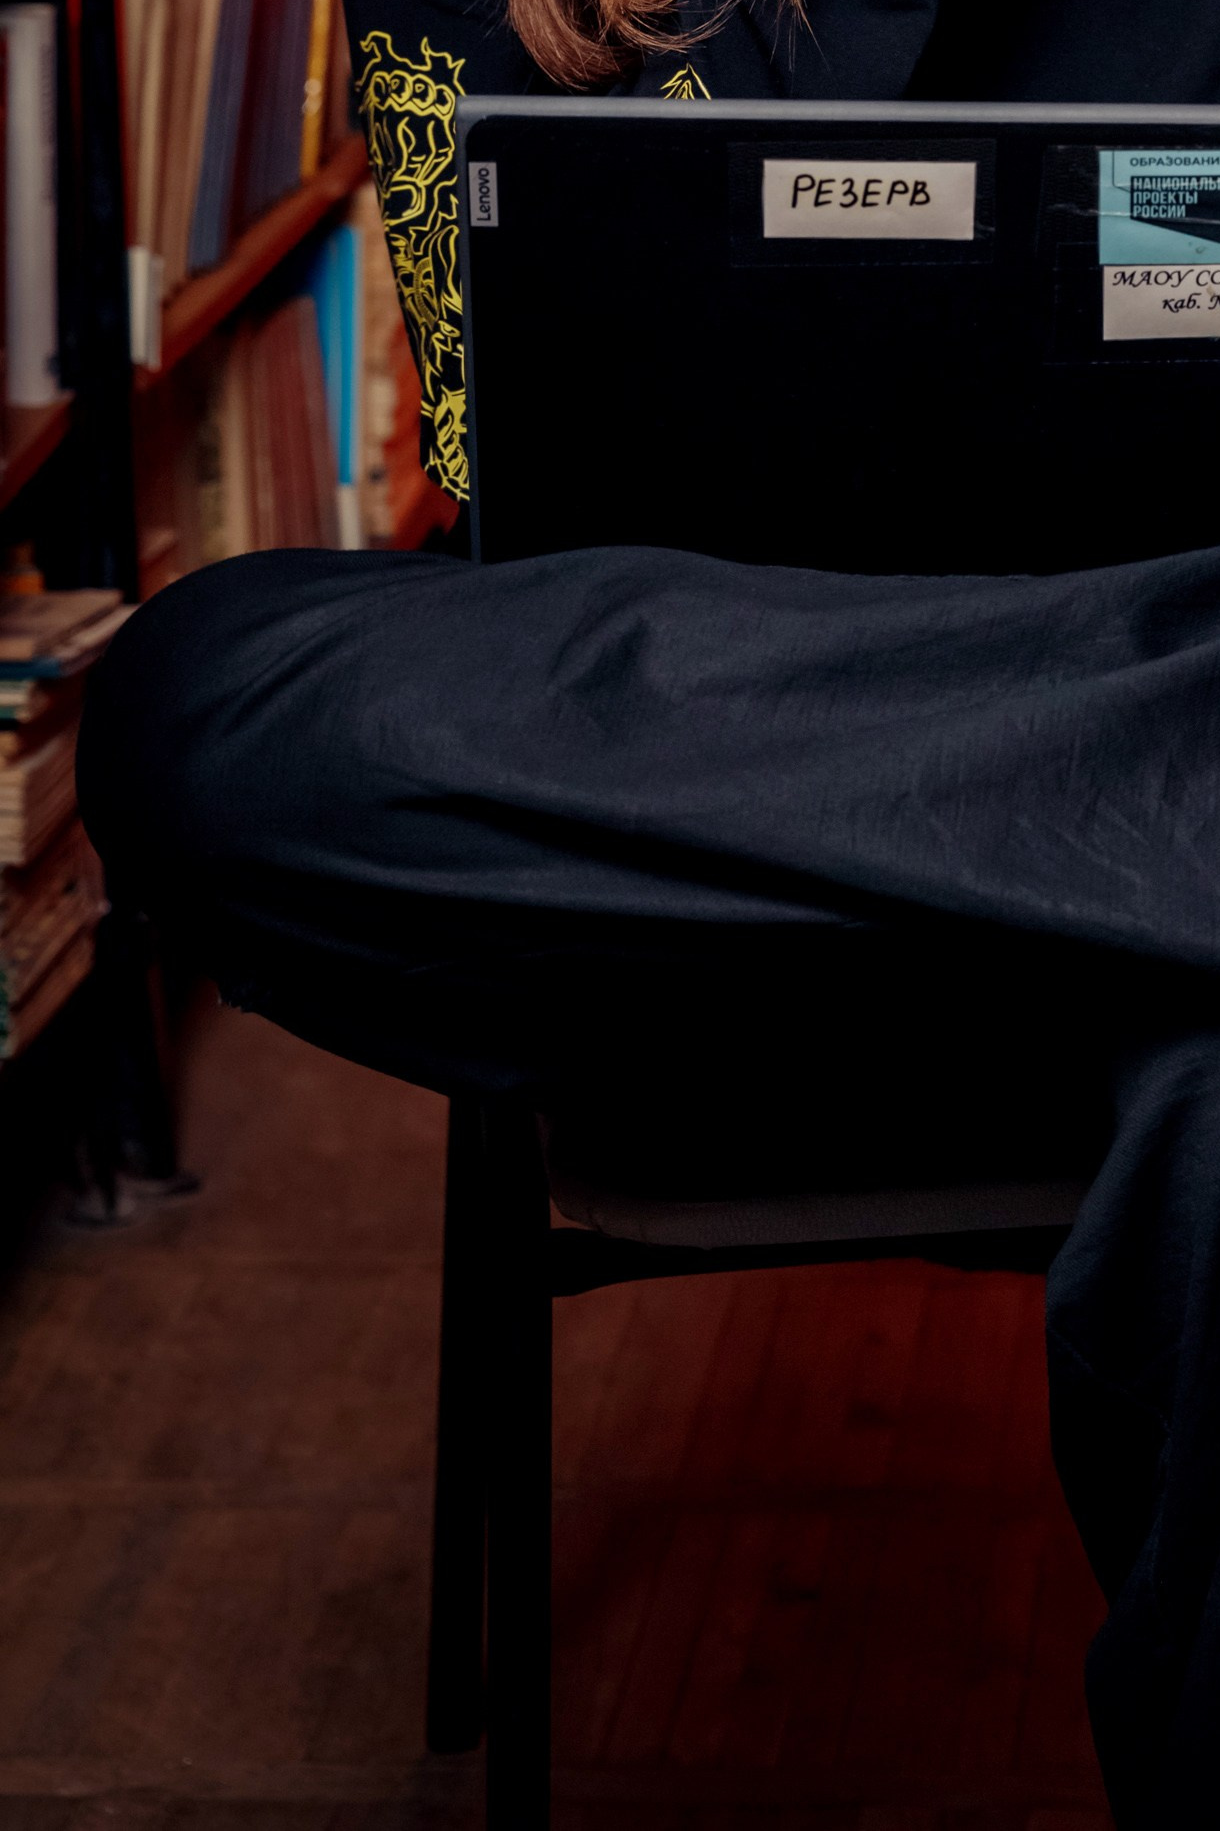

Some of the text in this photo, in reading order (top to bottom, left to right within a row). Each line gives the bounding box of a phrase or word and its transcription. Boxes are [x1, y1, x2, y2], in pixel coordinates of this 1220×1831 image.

[477, 168, 491, 221] Lenovo
[791, 174, 931, 209] РЕЗЕРВ
[1133, 191, 1198, 204] ПРОЕКТЫ
[1133, 205, 1186, 218] РОССИИ
[1112, 269, 1194, 288] МАОУ
[1161, 292, 1201, 313] каб.
